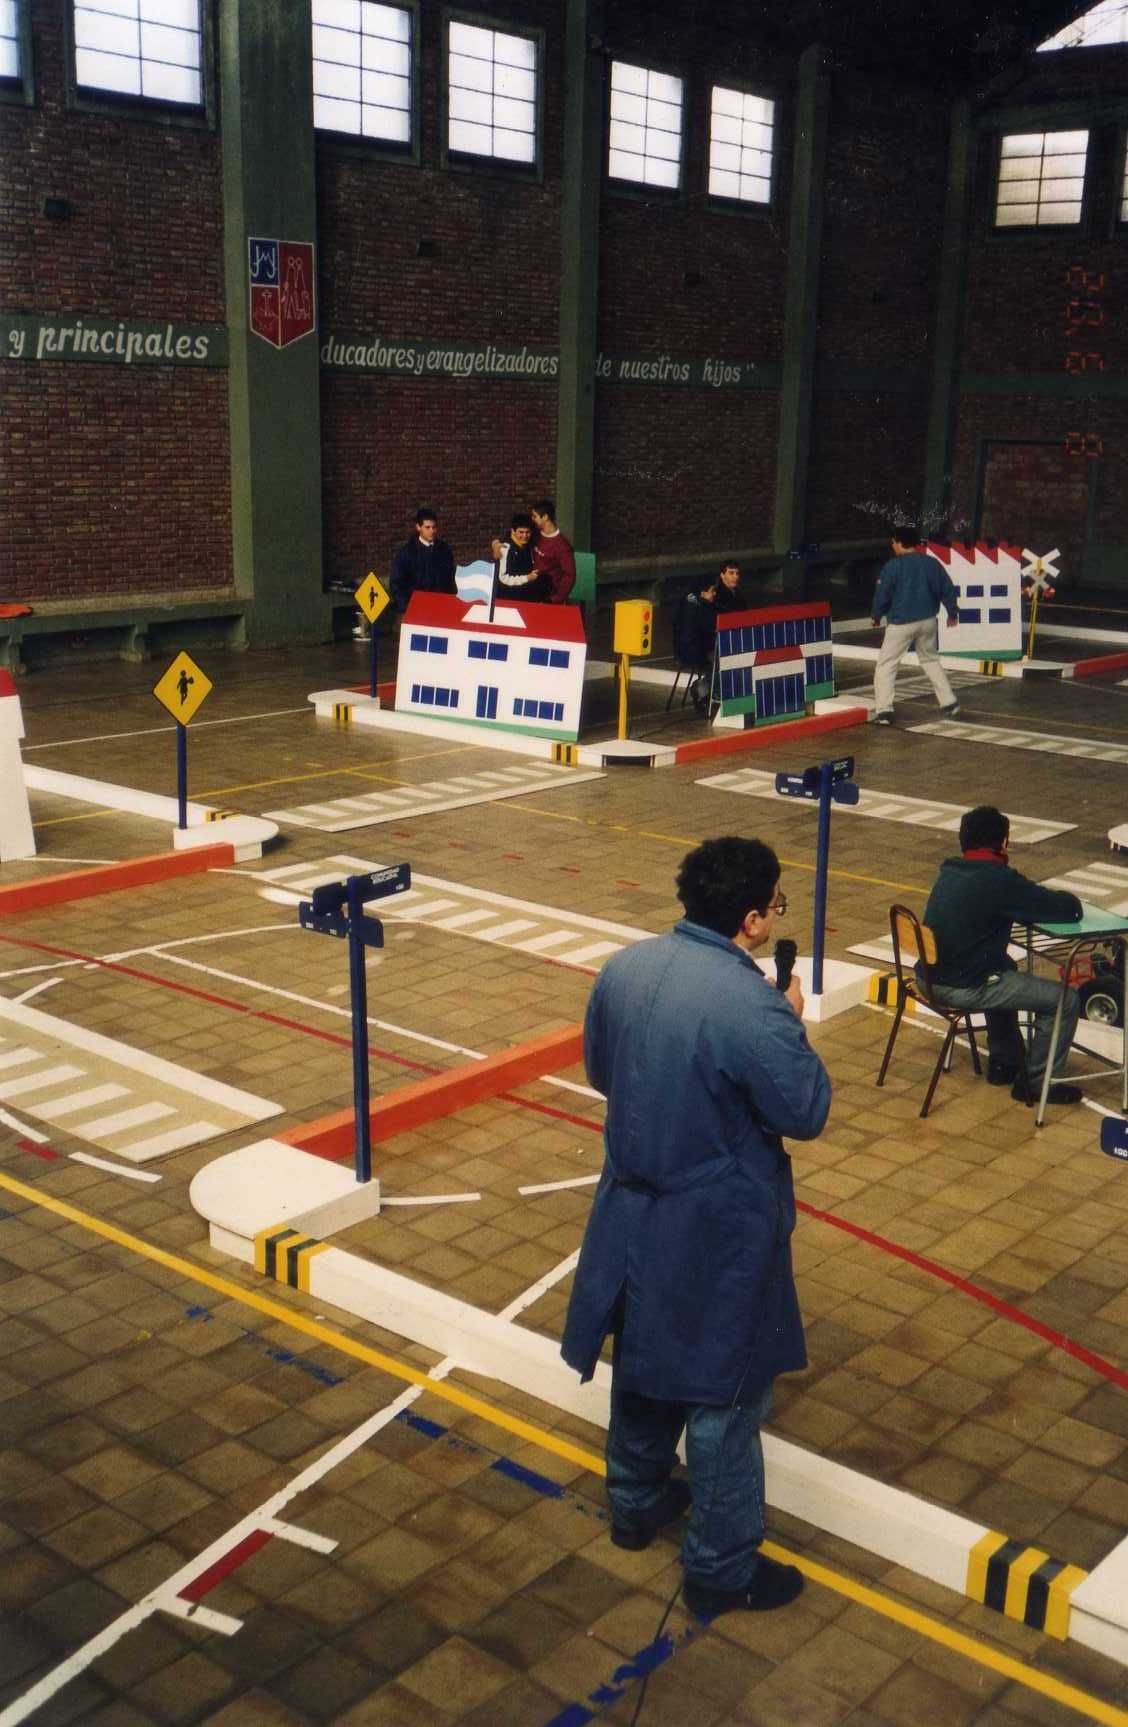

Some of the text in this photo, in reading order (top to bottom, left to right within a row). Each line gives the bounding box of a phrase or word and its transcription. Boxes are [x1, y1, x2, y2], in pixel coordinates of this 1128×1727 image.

[37, 320, 210, 363] principales
[426, 345, 560, 377] evangelizadores
[619, 354, 691, 381] nuestros
